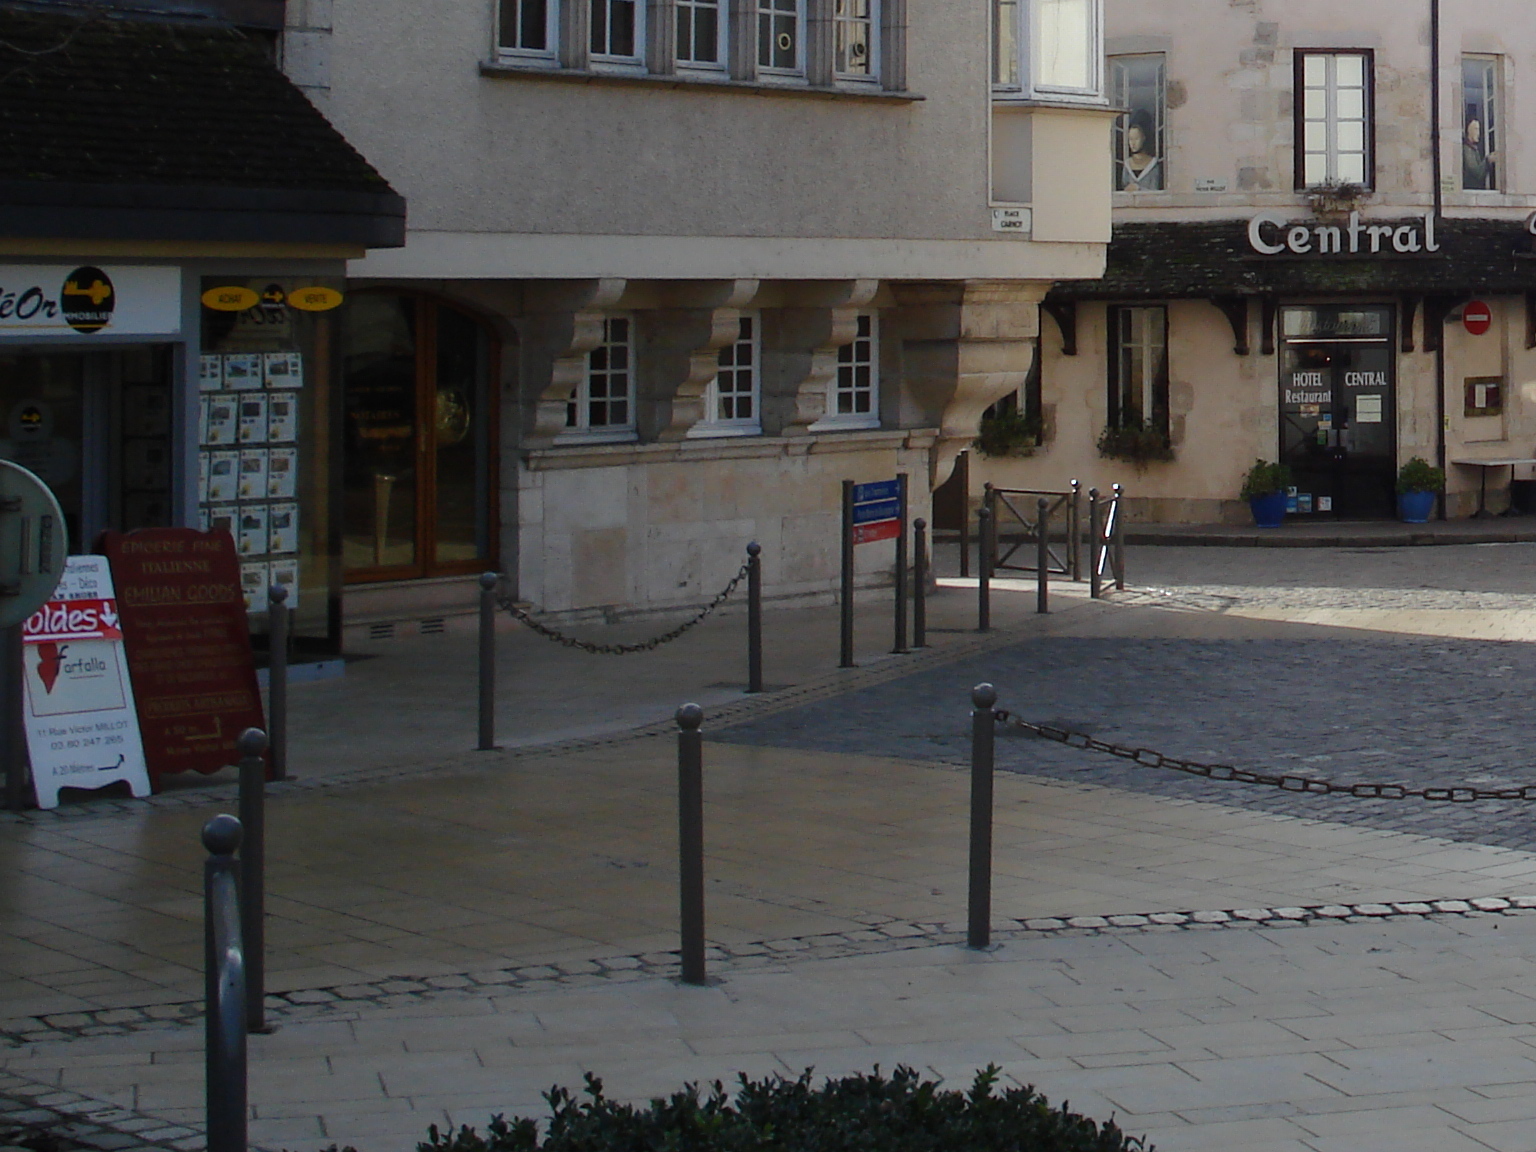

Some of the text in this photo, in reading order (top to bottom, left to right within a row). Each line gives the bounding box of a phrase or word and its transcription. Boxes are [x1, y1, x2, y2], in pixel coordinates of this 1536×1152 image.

[1247, 210, 1440, 255] Central
[0, 286, 58, 320] éOr
[1292, 371, 1387, 387] HOTEL CENTRAL
[1285, 389, 1332, 404] Restaurant
[23, 604, 98, 634] oldes
